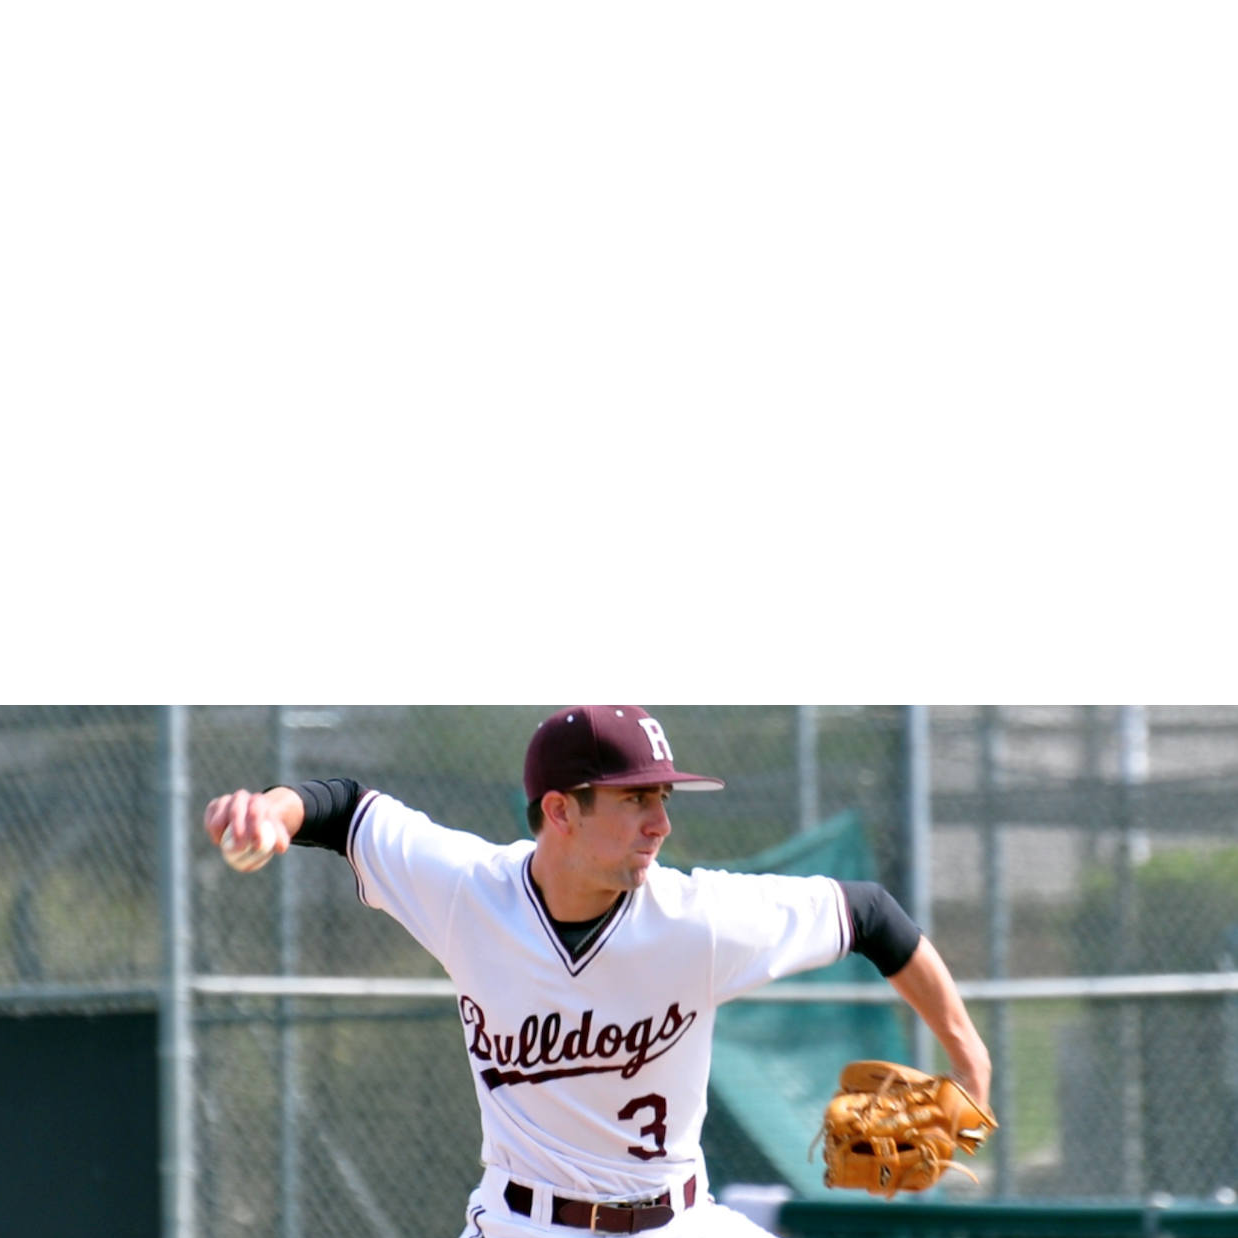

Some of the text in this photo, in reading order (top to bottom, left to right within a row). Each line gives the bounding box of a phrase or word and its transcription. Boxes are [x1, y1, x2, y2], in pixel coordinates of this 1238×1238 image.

[637, 718, 673, 762] R
[460, 995, 697, 1085] Bulldogs
[617, 1092, 667, 1161] 3
